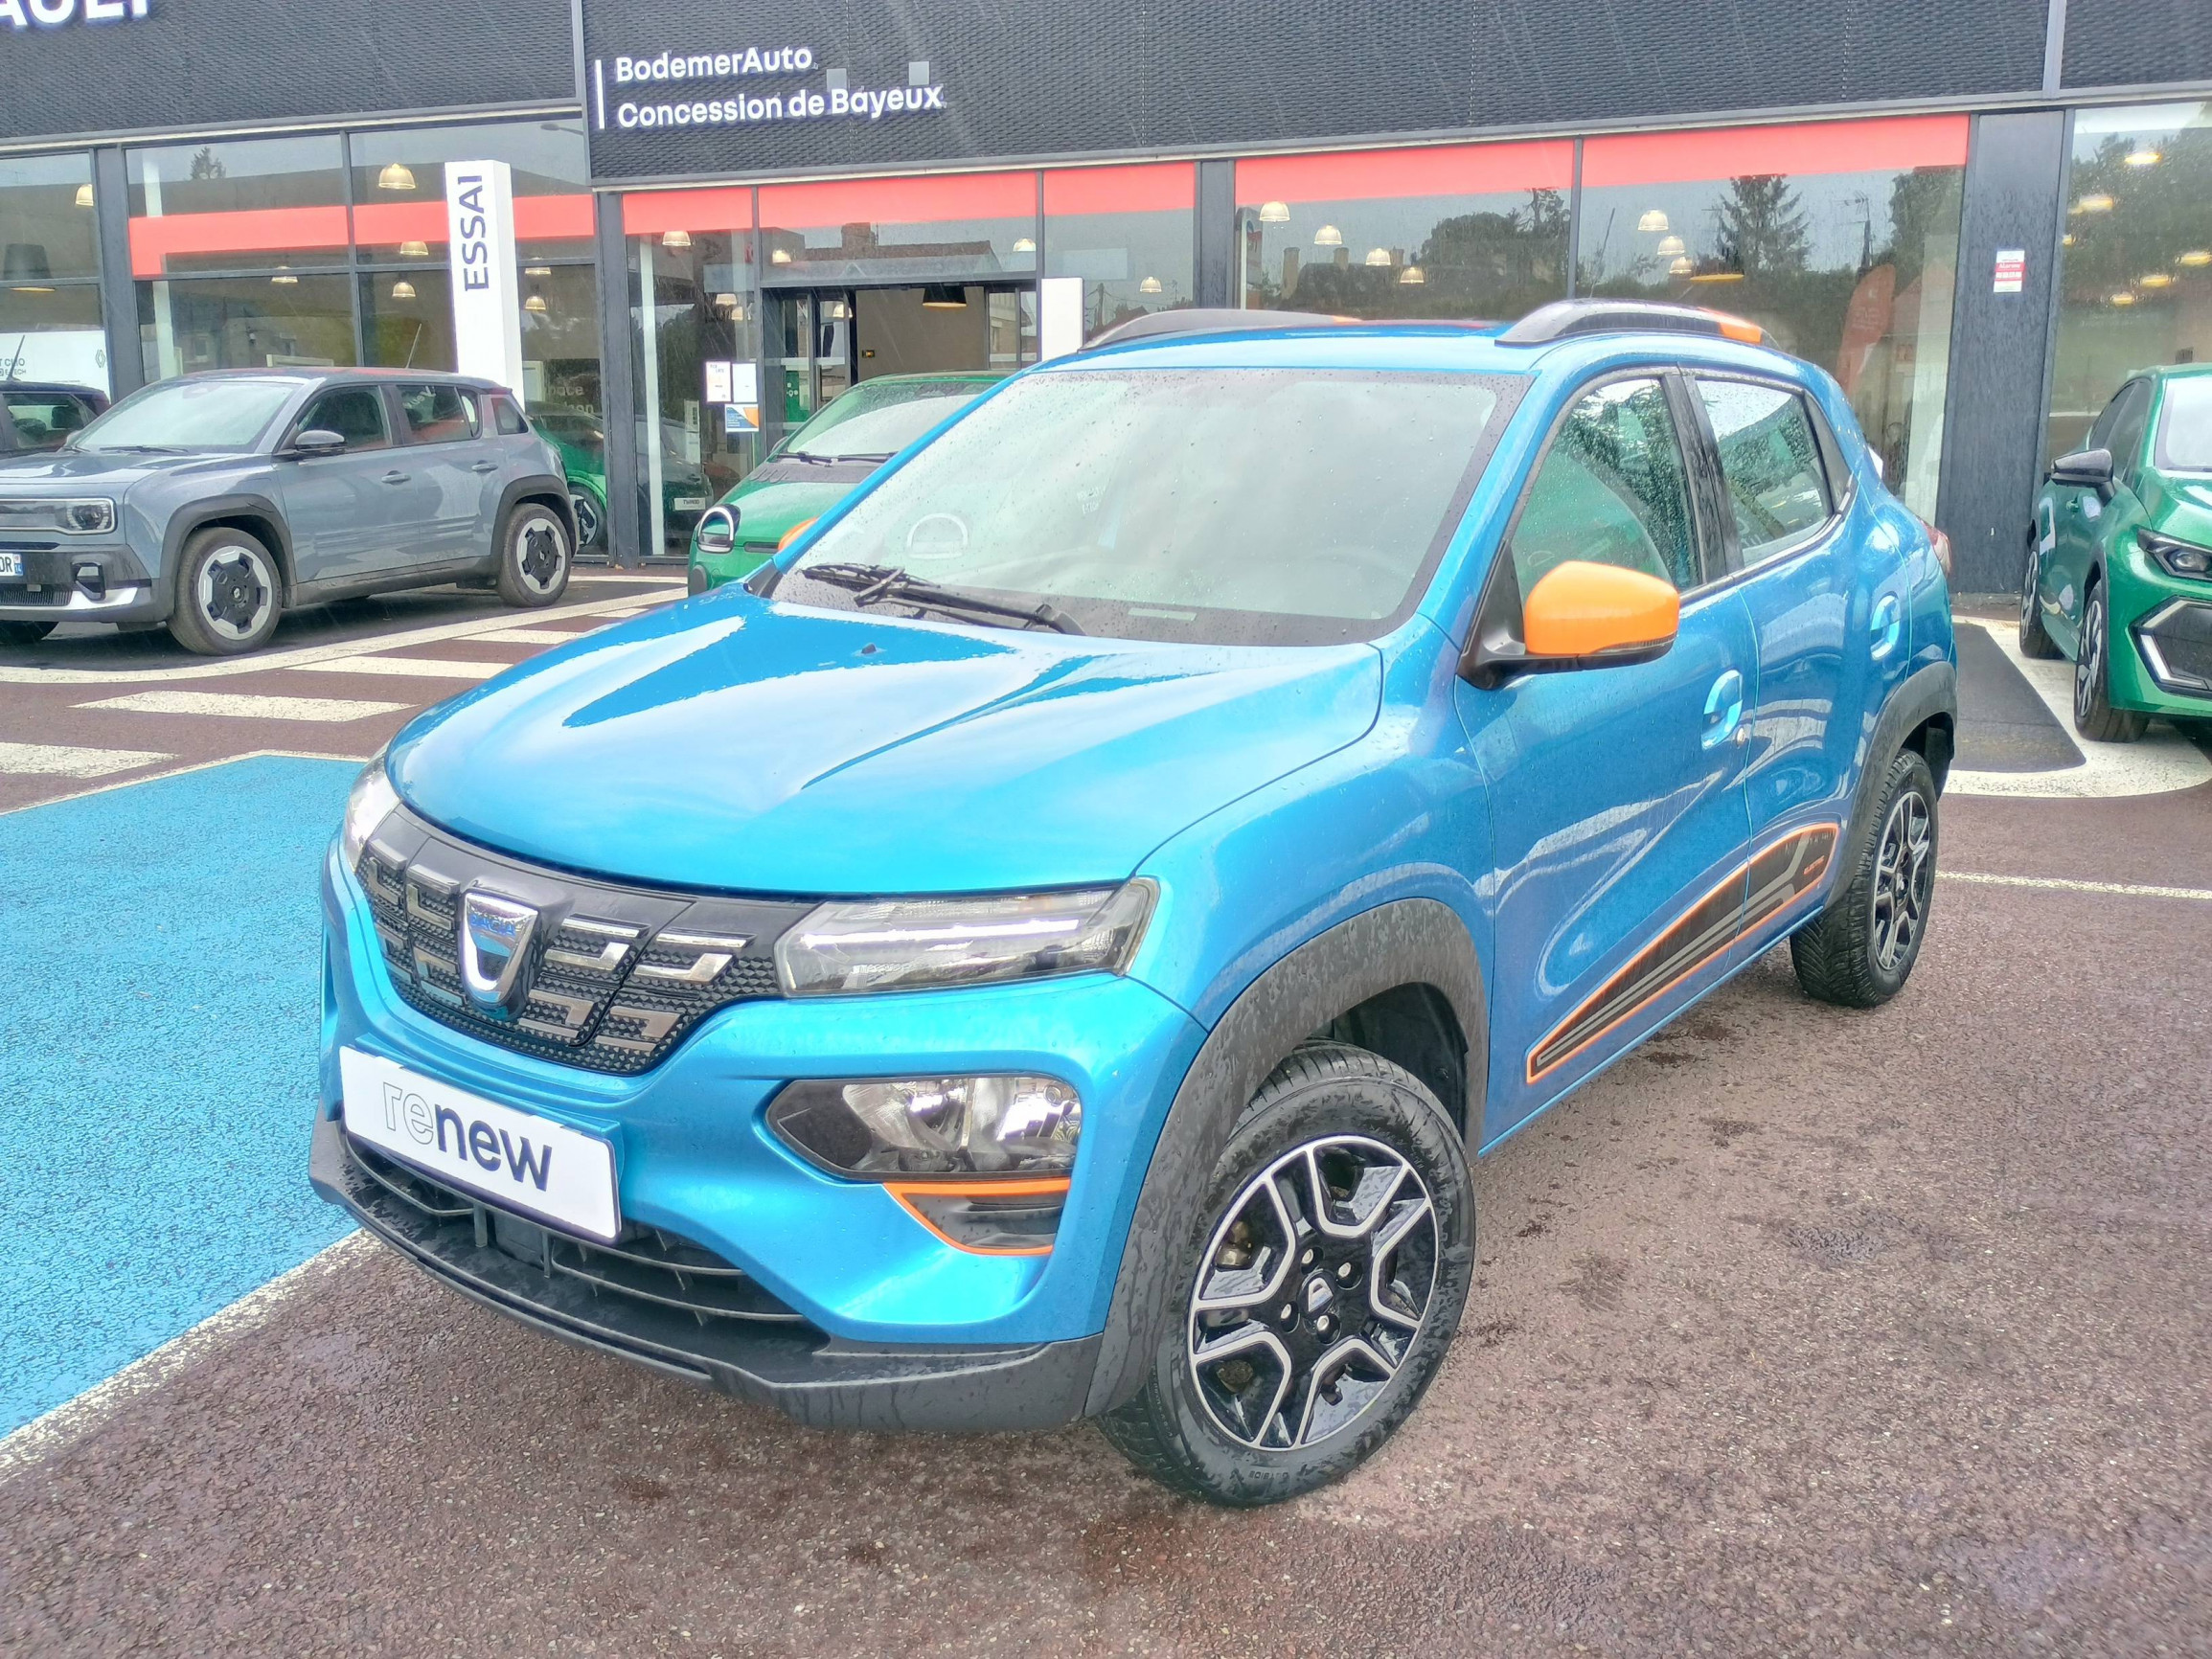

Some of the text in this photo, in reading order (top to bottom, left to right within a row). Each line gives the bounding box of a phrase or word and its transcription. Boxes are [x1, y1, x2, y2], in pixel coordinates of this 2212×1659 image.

[616, 46, 812, 82] BodemerAuto
[618, 86, 943, 127] Concession de Bayeux
[457, 175, 490, 291] ESSAI
[383, 1081, 553, 1192] renew
